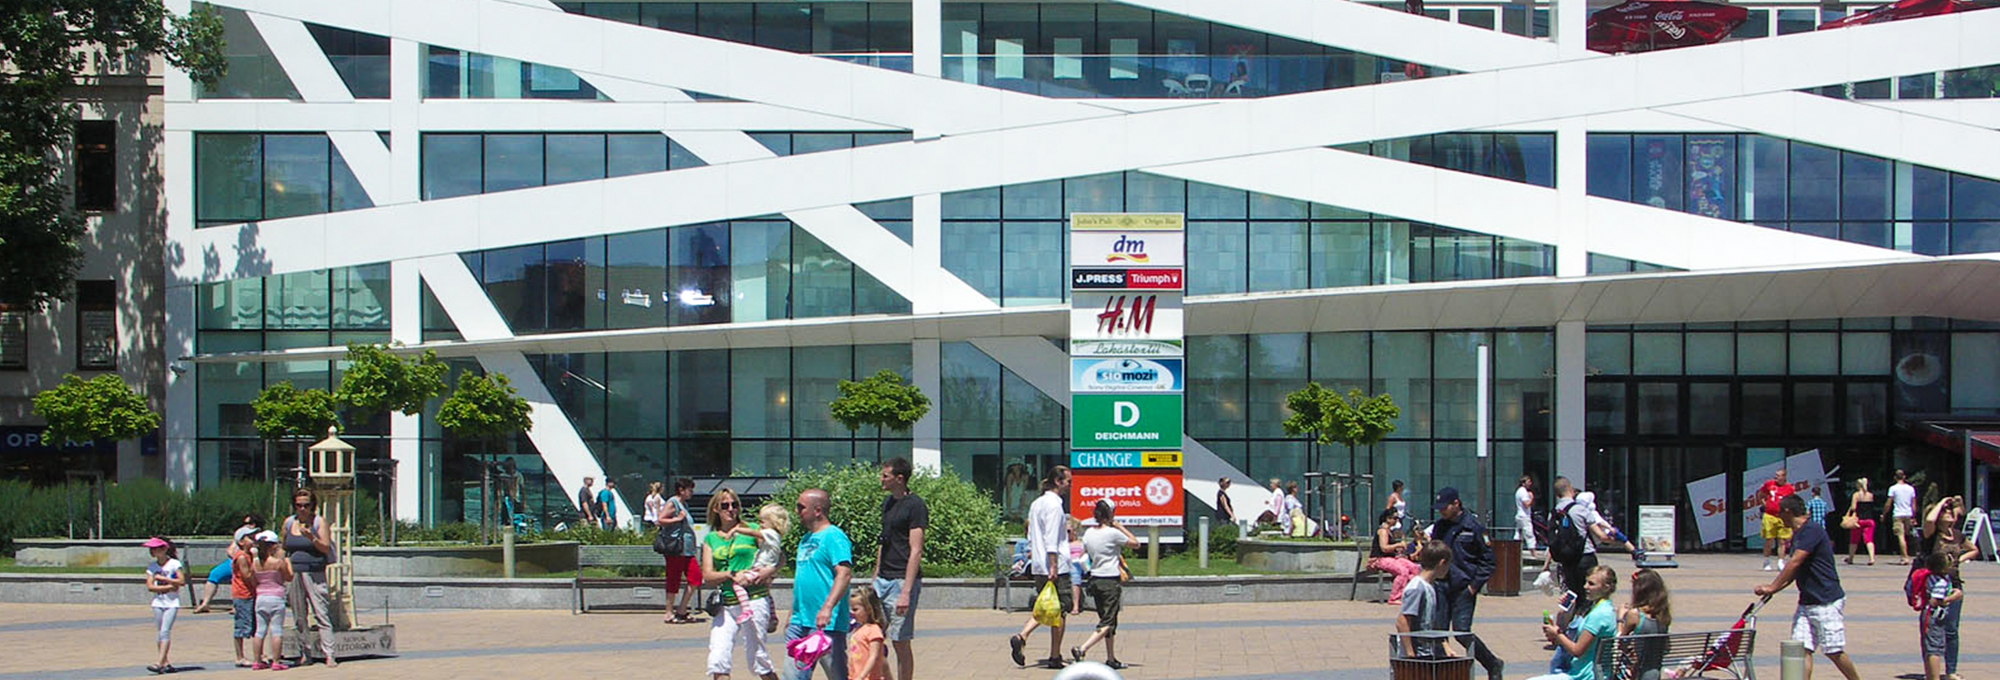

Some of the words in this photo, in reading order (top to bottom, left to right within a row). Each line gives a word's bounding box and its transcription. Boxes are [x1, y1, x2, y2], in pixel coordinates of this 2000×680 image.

[1113, 234, 1145, 253] dm
[1075, 274, 1124, 284] J.PRESS
[1131, 274, 1171, 285] Triumph
[1097, 294, 1157, 335] H&M
[1113, 401, 1140, 428] D
[1094, 431, 1160, 441] DEICHMANN
[1077, 452, 1133, 467] CHANGE
[1079, 485, 1142, 500] expert
